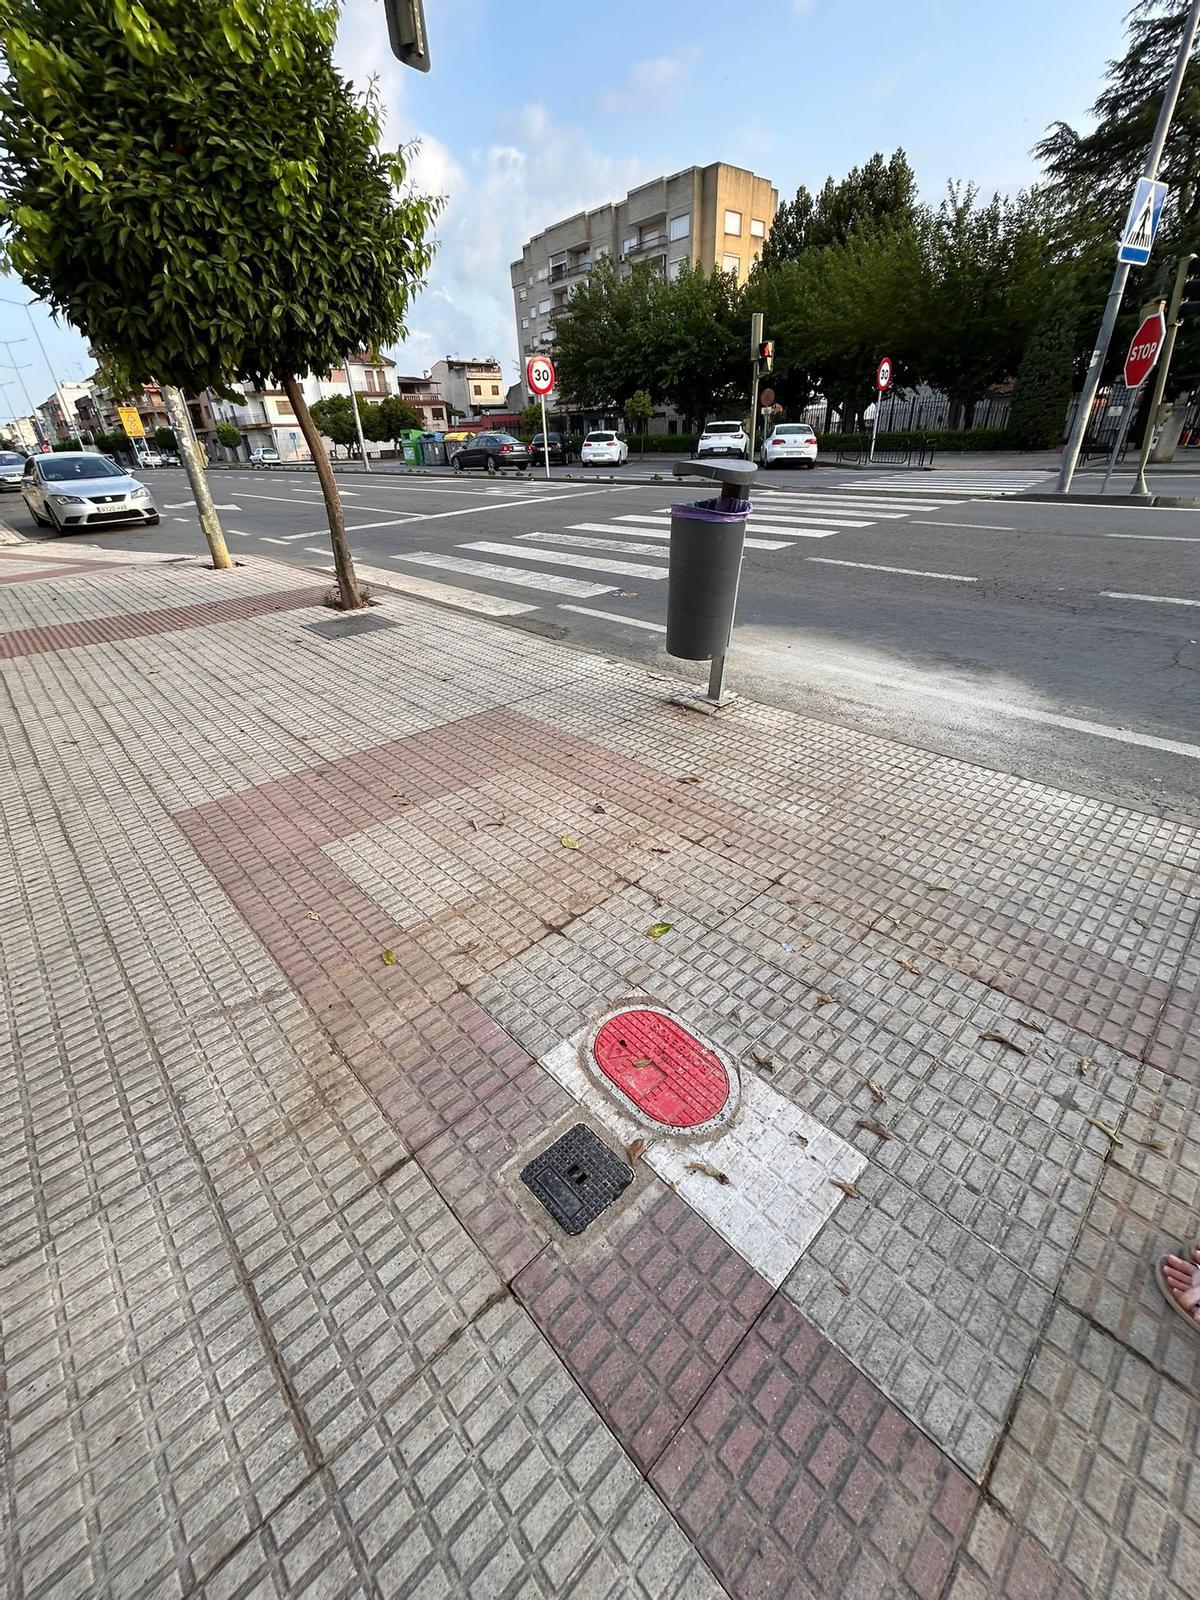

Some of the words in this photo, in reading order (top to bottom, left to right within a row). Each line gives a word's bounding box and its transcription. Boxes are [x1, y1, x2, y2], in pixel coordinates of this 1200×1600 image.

[1129, 342, 1158, 361] STOP
[534, 368, 549, 382] 30
[881, 369, 888, 380] 30
[649, 1022, 711, 1075] BOMBEROS
